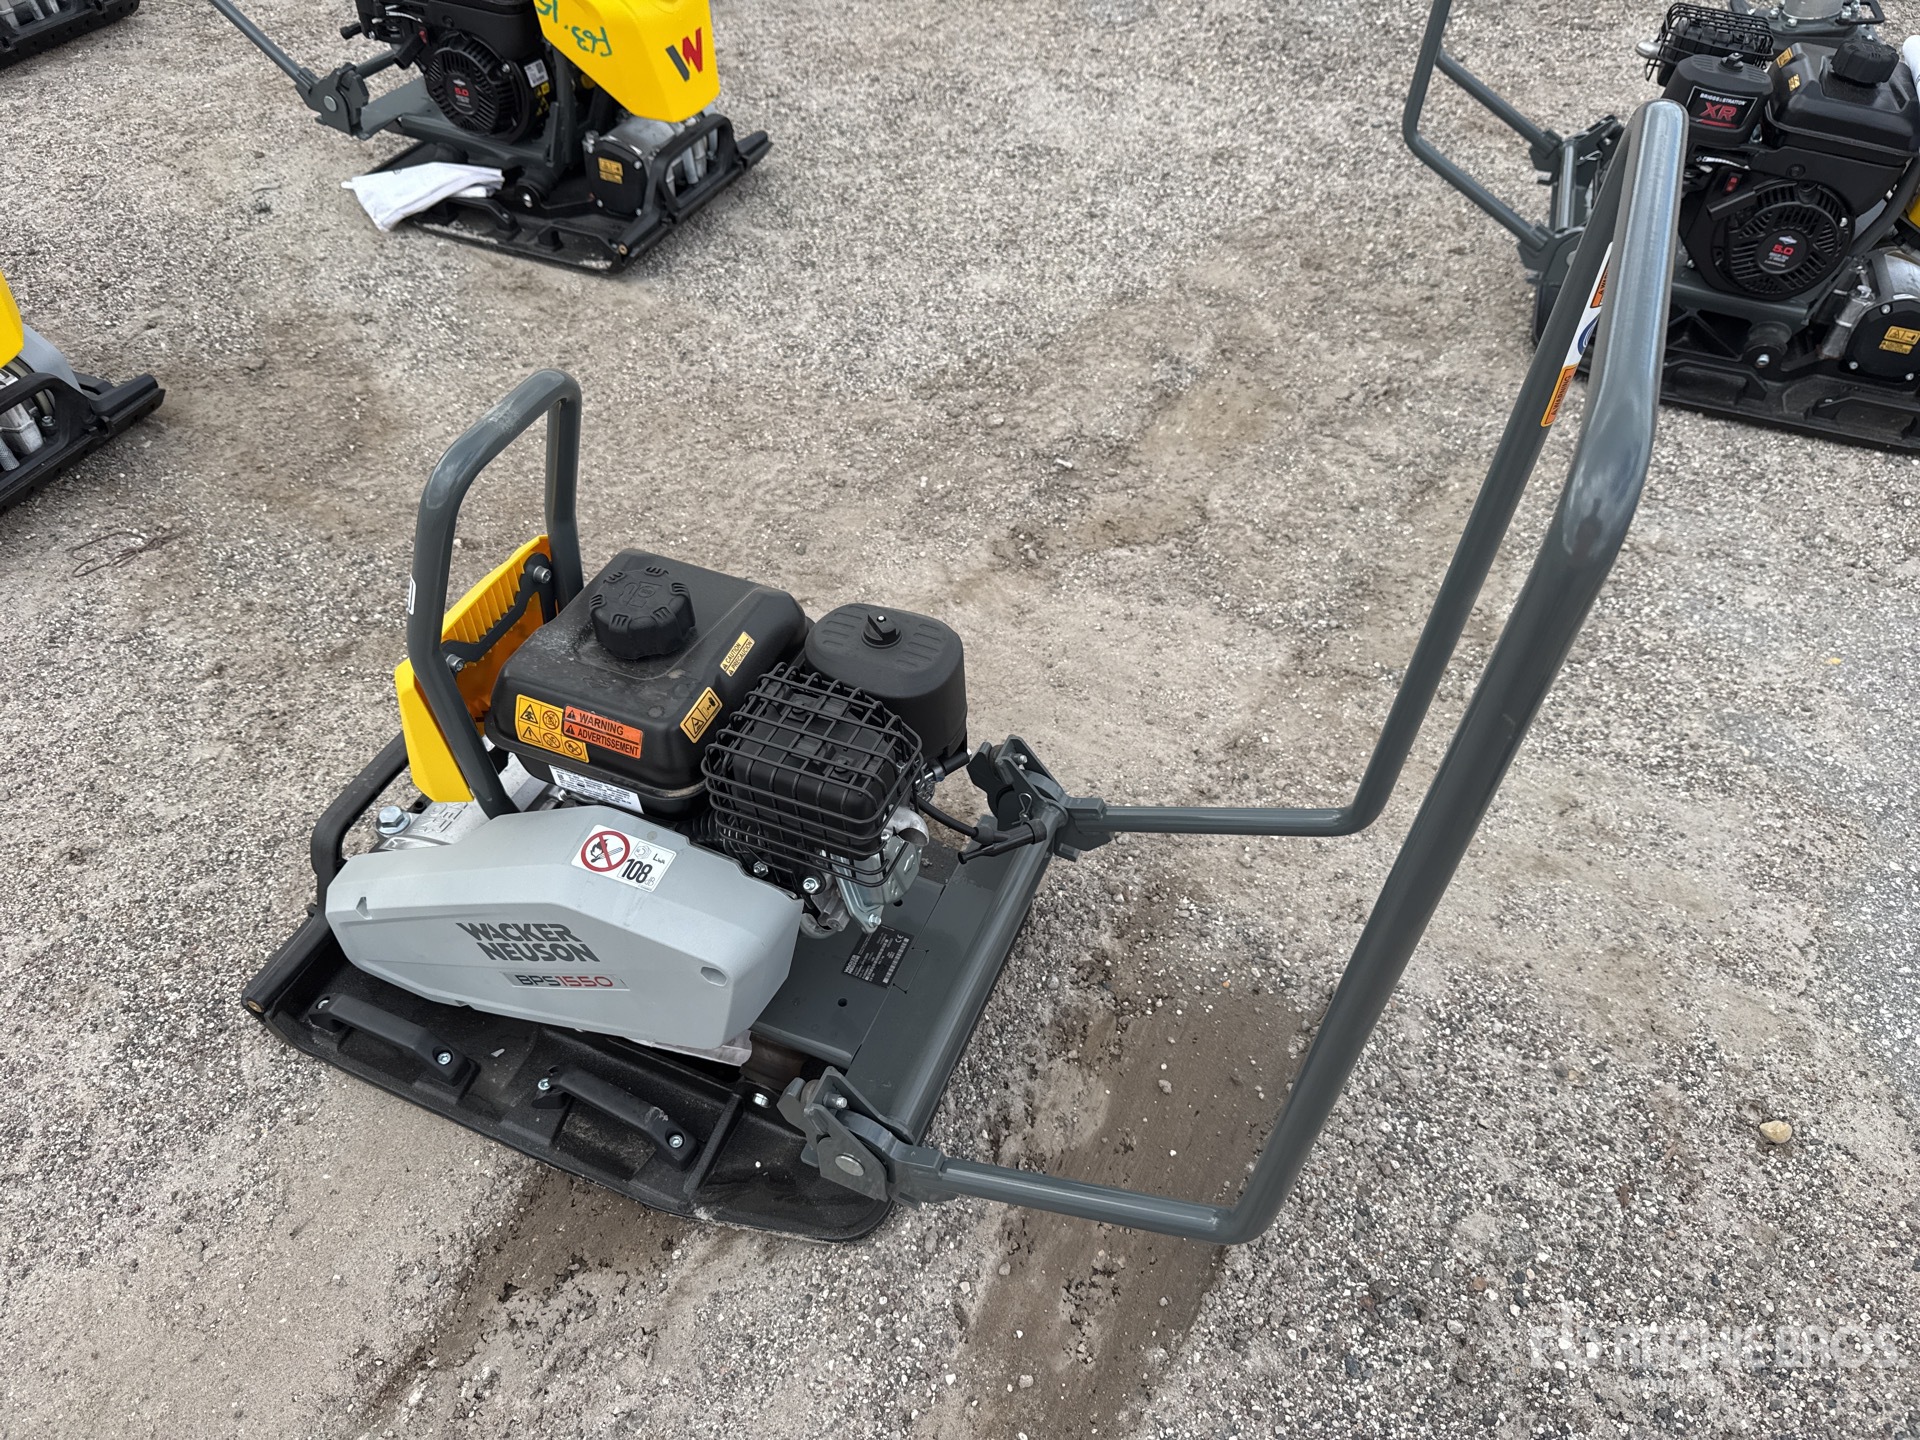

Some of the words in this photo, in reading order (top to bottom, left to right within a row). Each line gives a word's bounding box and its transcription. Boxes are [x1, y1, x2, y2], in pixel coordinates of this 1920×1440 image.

[1699, 101, 1737, 121] XR
[1773, 244, 1794, 256] 5.0
[725, 643, 741, 664] CAUTION
[579, 713, 624, 736] WARNING
[578, 729, 640, 756] ADVERTISSEMENT
[621, 858, 653, 883] 108
[456, 923, 583, 942] WACKER
[477, 942, 600, 962] NEUSON
[514, 975, 613, 987] BPS1550
